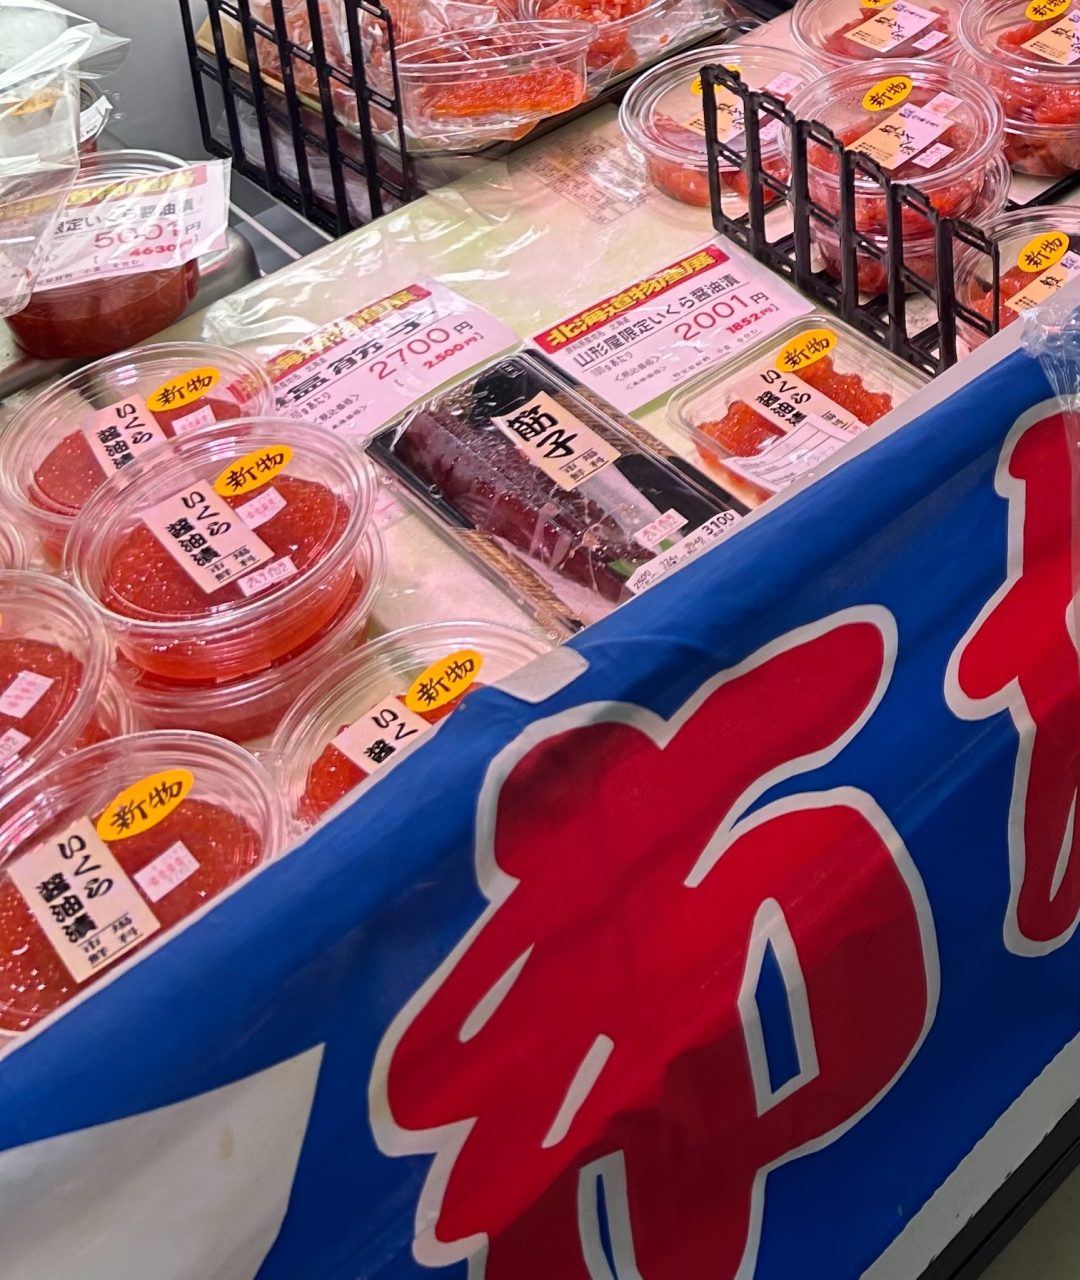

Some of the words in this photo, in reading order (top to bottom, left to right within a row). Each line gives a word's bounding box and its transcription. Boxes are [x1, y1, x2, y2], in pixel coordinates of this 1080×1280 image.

[869, 80, 908, 110] 新物
[1023, 236, 1065, 269] 新物
[546, 249, 718, 348] 北海道物産展
[571, 271, 742, 369] 山形屋限定いくら醤油漬
[785, 335, 830, 368] 新物
[156, 374, 213, 408] 新物
[760, 369, 812, 405] いくら
[115, 401, 154, 445] いくら
[506, 404, 579, 459] 筋子
[97, 424, 136, 471] 醤油漬
[225, 451, 285, 493] 新物
[181, 490, 233, 537] いくら
[166, 517, 222, 567] 醤油漬
[415, 659, 477, 706] 新物
[110, 779, 185, 834] 新物
[58, 833, 116, 900] いくら
[37, 871, 99, 946] 醤油漬
